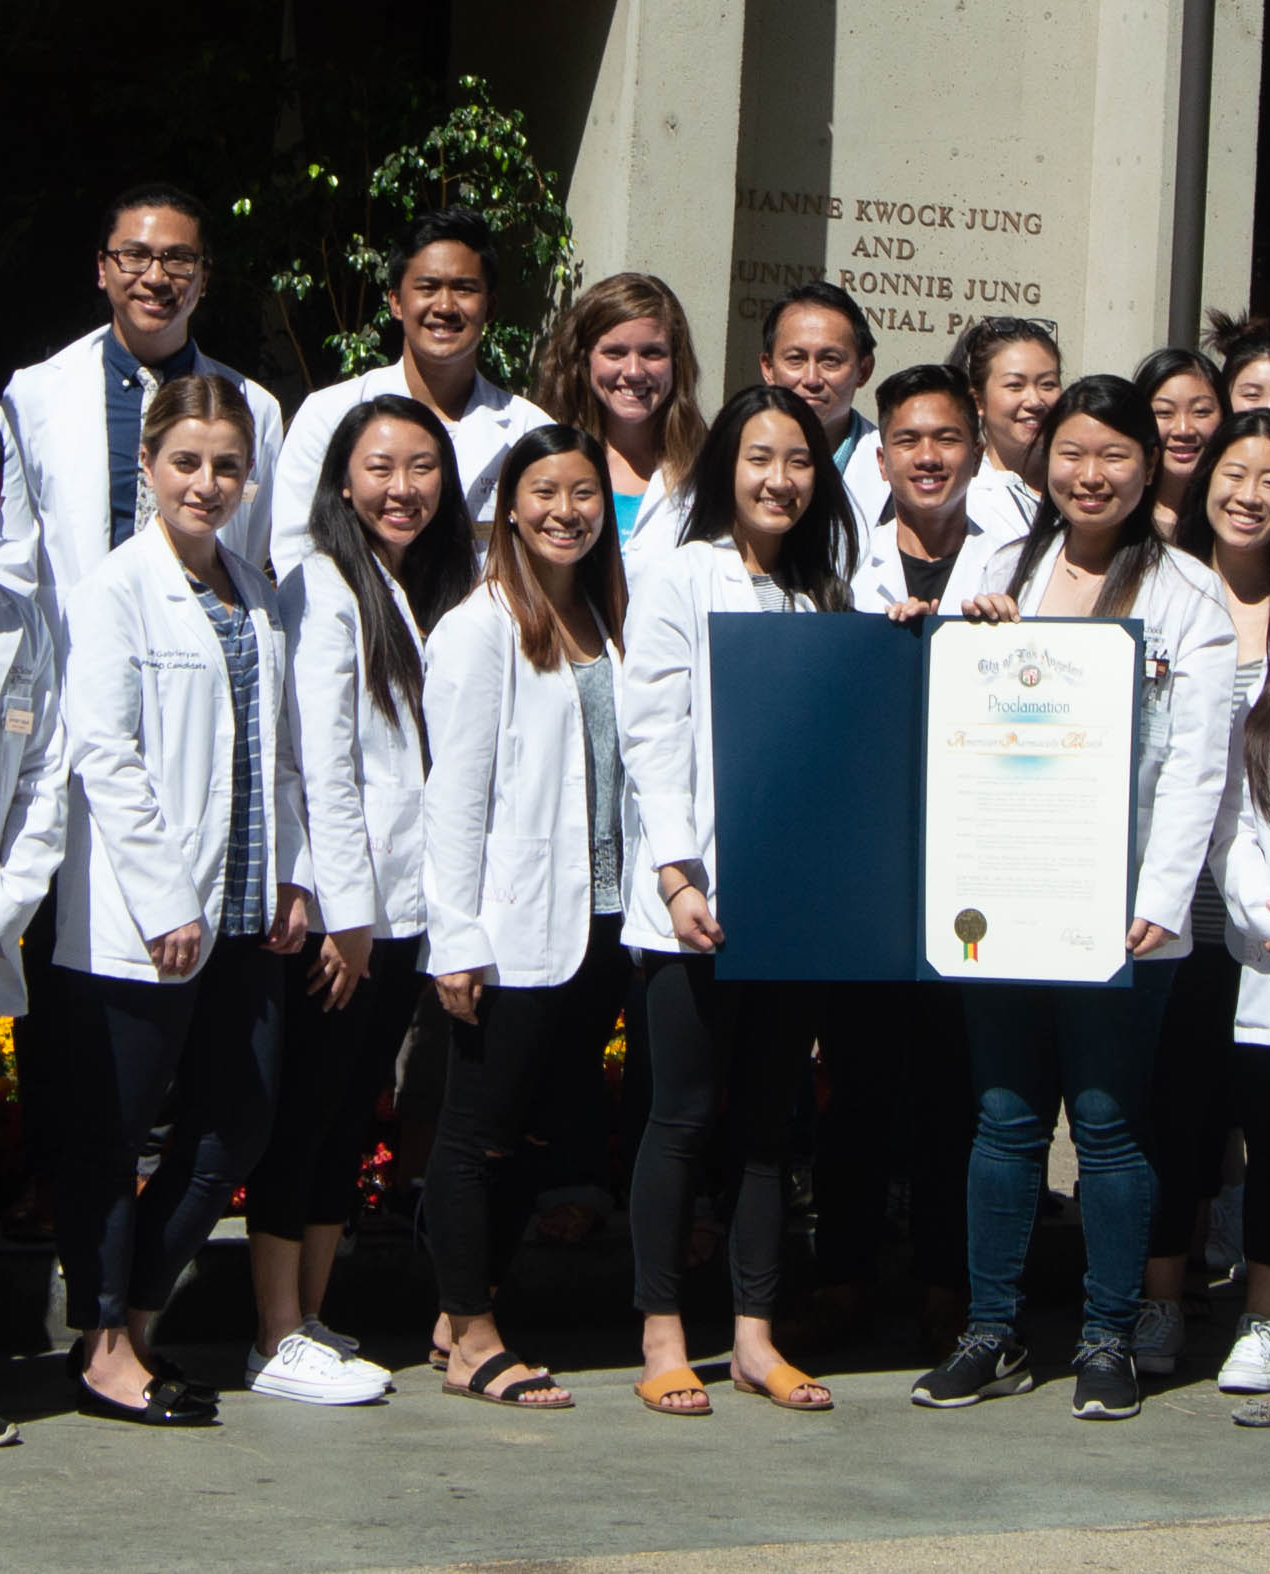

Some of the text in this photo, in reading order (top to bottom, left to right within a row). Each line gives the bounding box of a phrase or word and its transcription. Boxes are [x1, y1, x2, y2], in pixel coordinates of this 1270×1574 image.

[855, 199, 955, 229] KWOCK
[964, 208, 1043, 235] JUNG
[851, 235, 916, 262] AND
[732, 260, 1042, 305] UNNY RONNIE JUNG
[739, 297, 936, 334] CENIAL
[988, 693, 1071, 714] Proclamation
